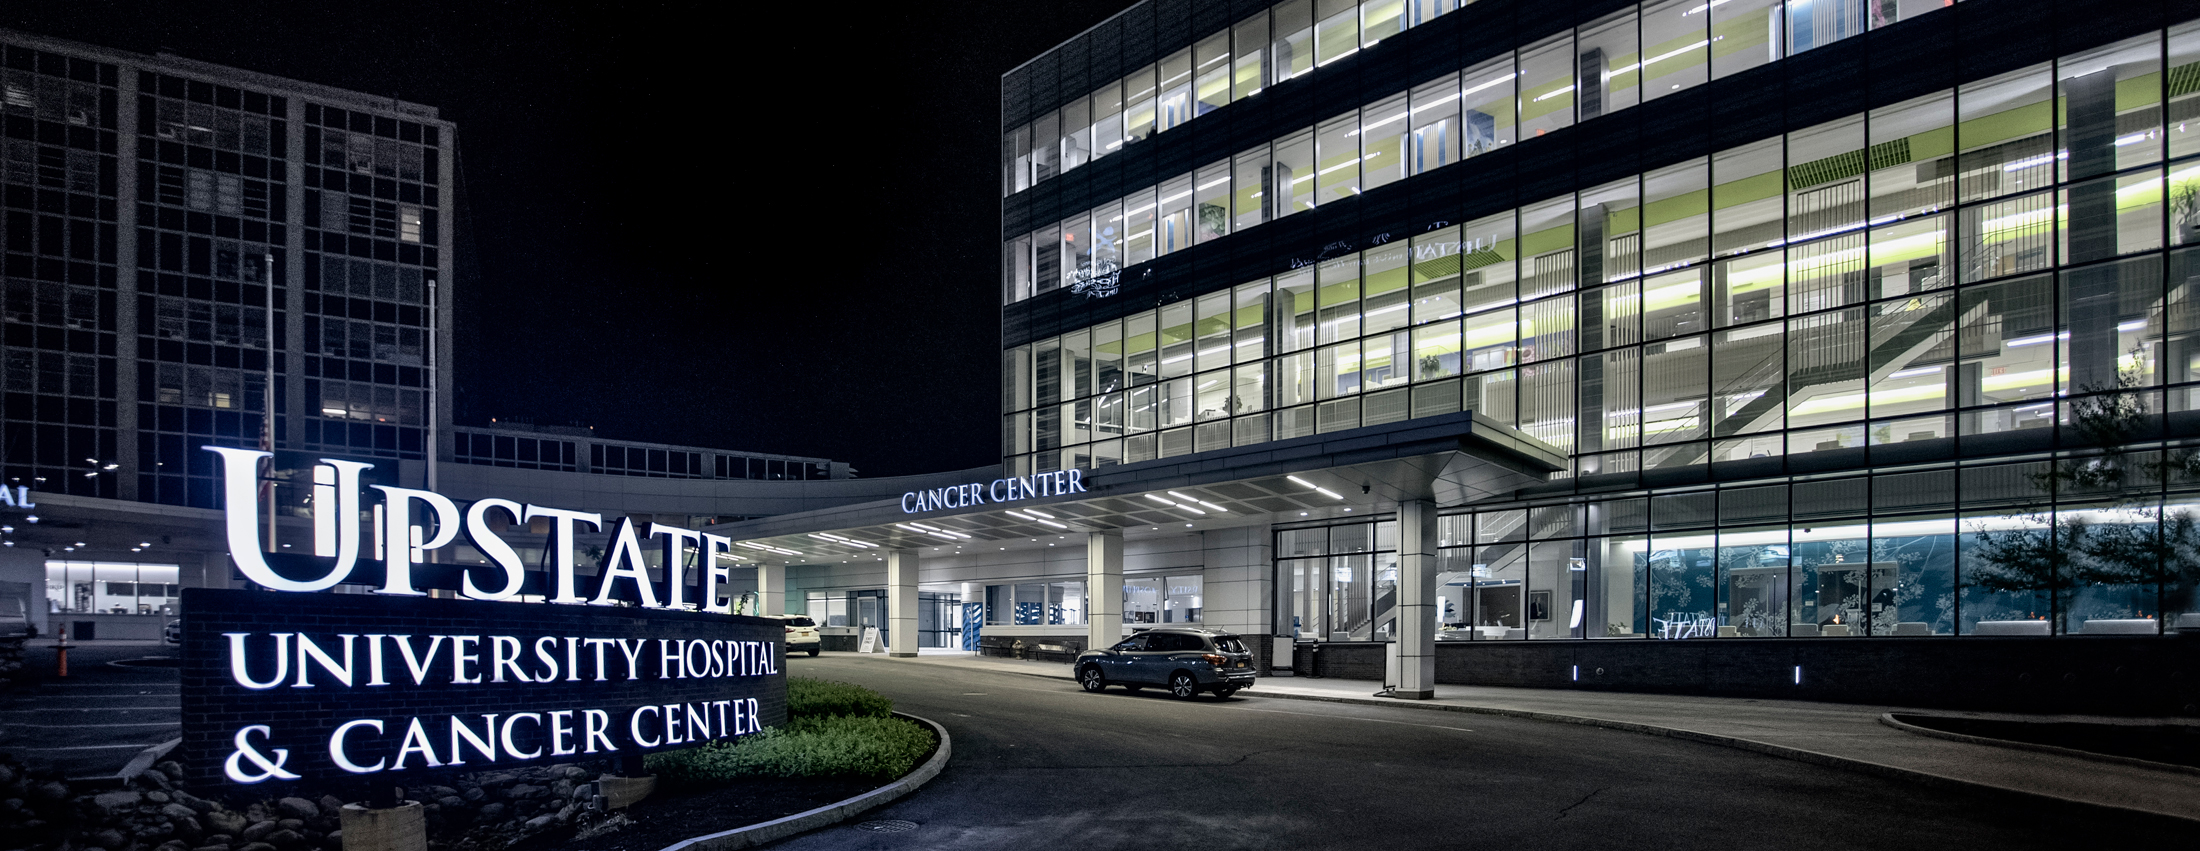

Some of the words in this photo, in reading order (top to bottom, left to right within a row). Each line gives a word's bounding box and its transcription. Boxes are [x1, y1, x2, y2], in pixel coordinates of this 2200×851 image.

[902, 482, 985, 514] CANCER
[990, 468, 1087, 503] CENTER
[201, 445, 731, 613] UPSTATE
[221, 632, 647, 690] UNIVERSITY
[658, 639, 778, 679] HOSPITAL
[224, 724, 302, 784] &
[328, 709, 620, 774] CANCER
[630, 697, 762, 748] CENTER
